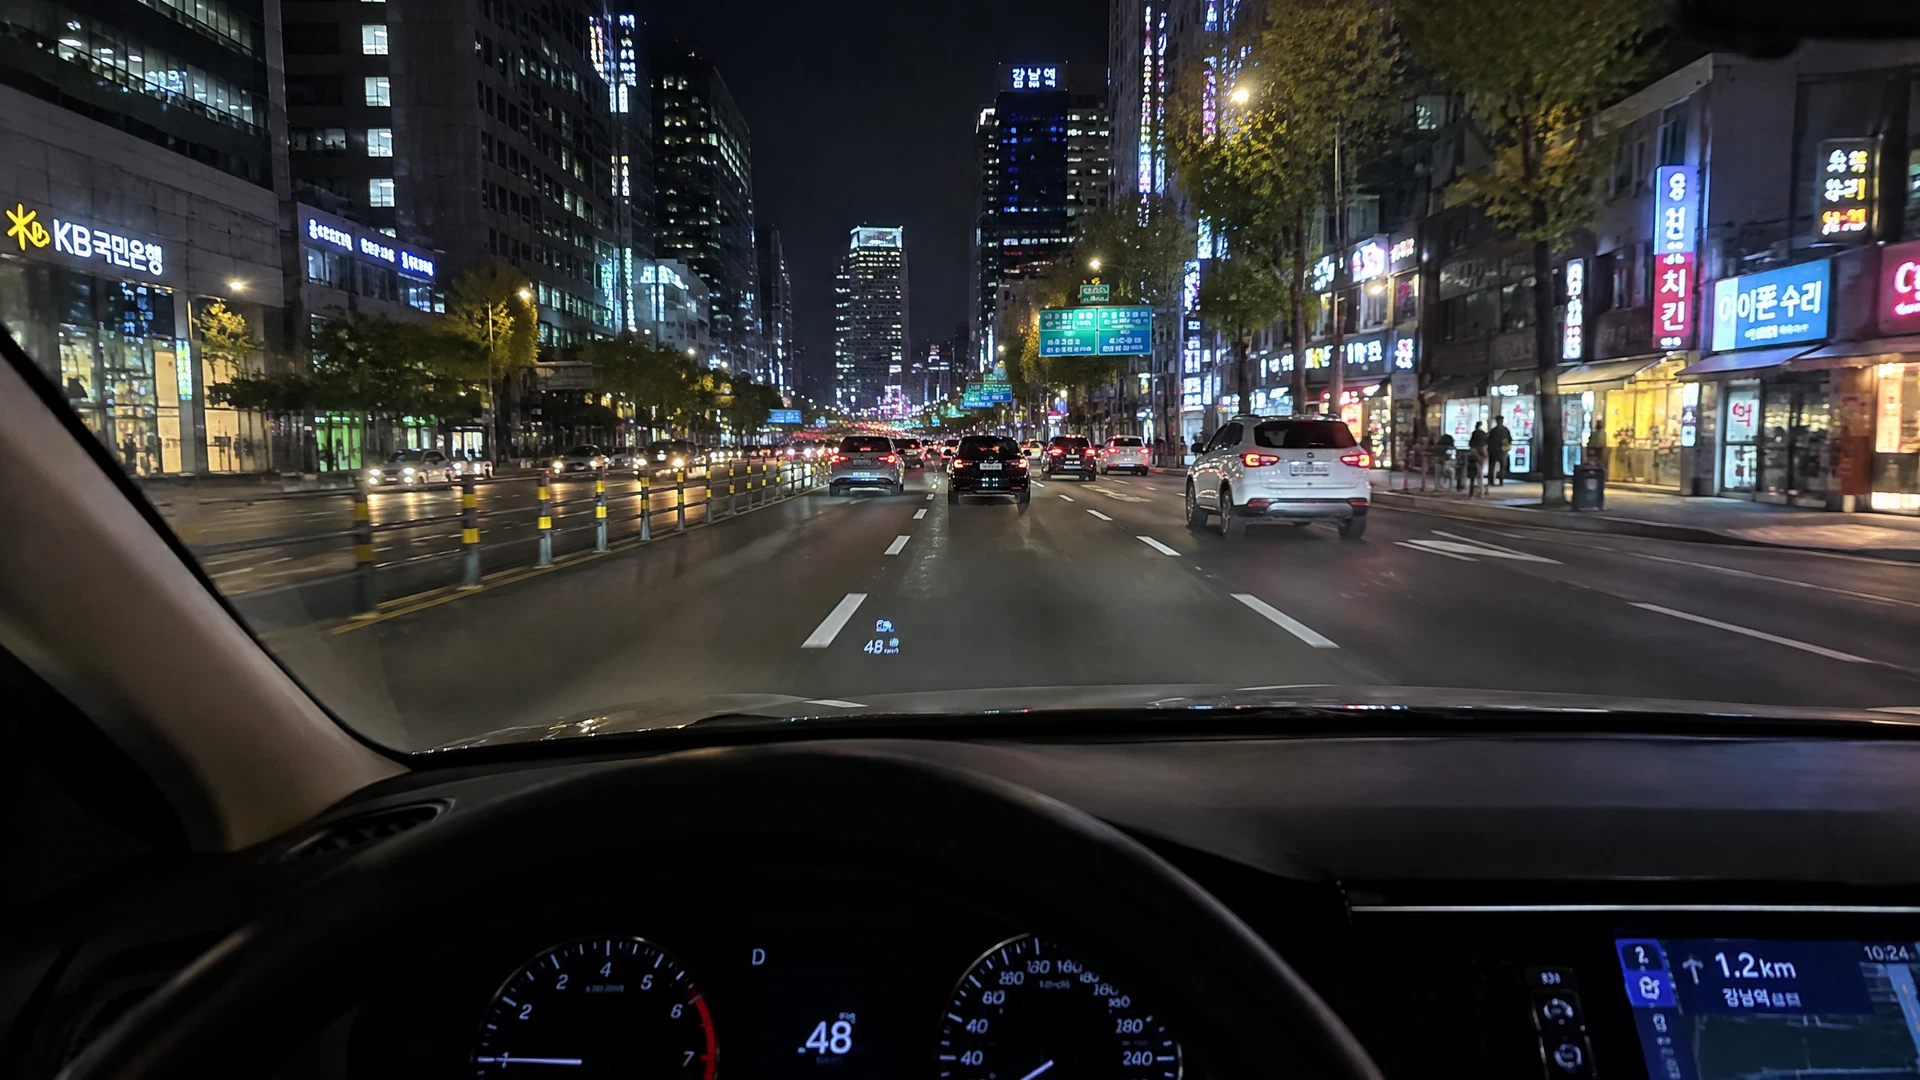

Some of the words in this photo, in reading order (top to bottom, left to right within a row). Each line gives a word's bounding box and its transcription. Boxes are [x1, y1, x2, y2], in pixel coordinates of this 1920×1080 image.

[53, 218, 163, 276] KB국민은행
[1660, 268, 1687, 332] 치킨
[1779, 280, 1822, 318] 수리
[863, 639, 884, 655] 48
[752, 948, 766, 966] D
[1863, 944, 1910, 961] 10:24
[599, 961, 612, 978] 4
[555, 973, 569, 991] 2
[640, 973, 654, 991] 5
[519, 1003, 533, 1021] 2
[670, 1003, 683, 1020] 6
[965, 1017, 989, 1035] 40
[805, 1019, 853, 1055] 48
[682, 1050, 695, 1067] 7
[960, 1049, 984, 1067] 40
[1122, 1050, 1154, 1067] 240
